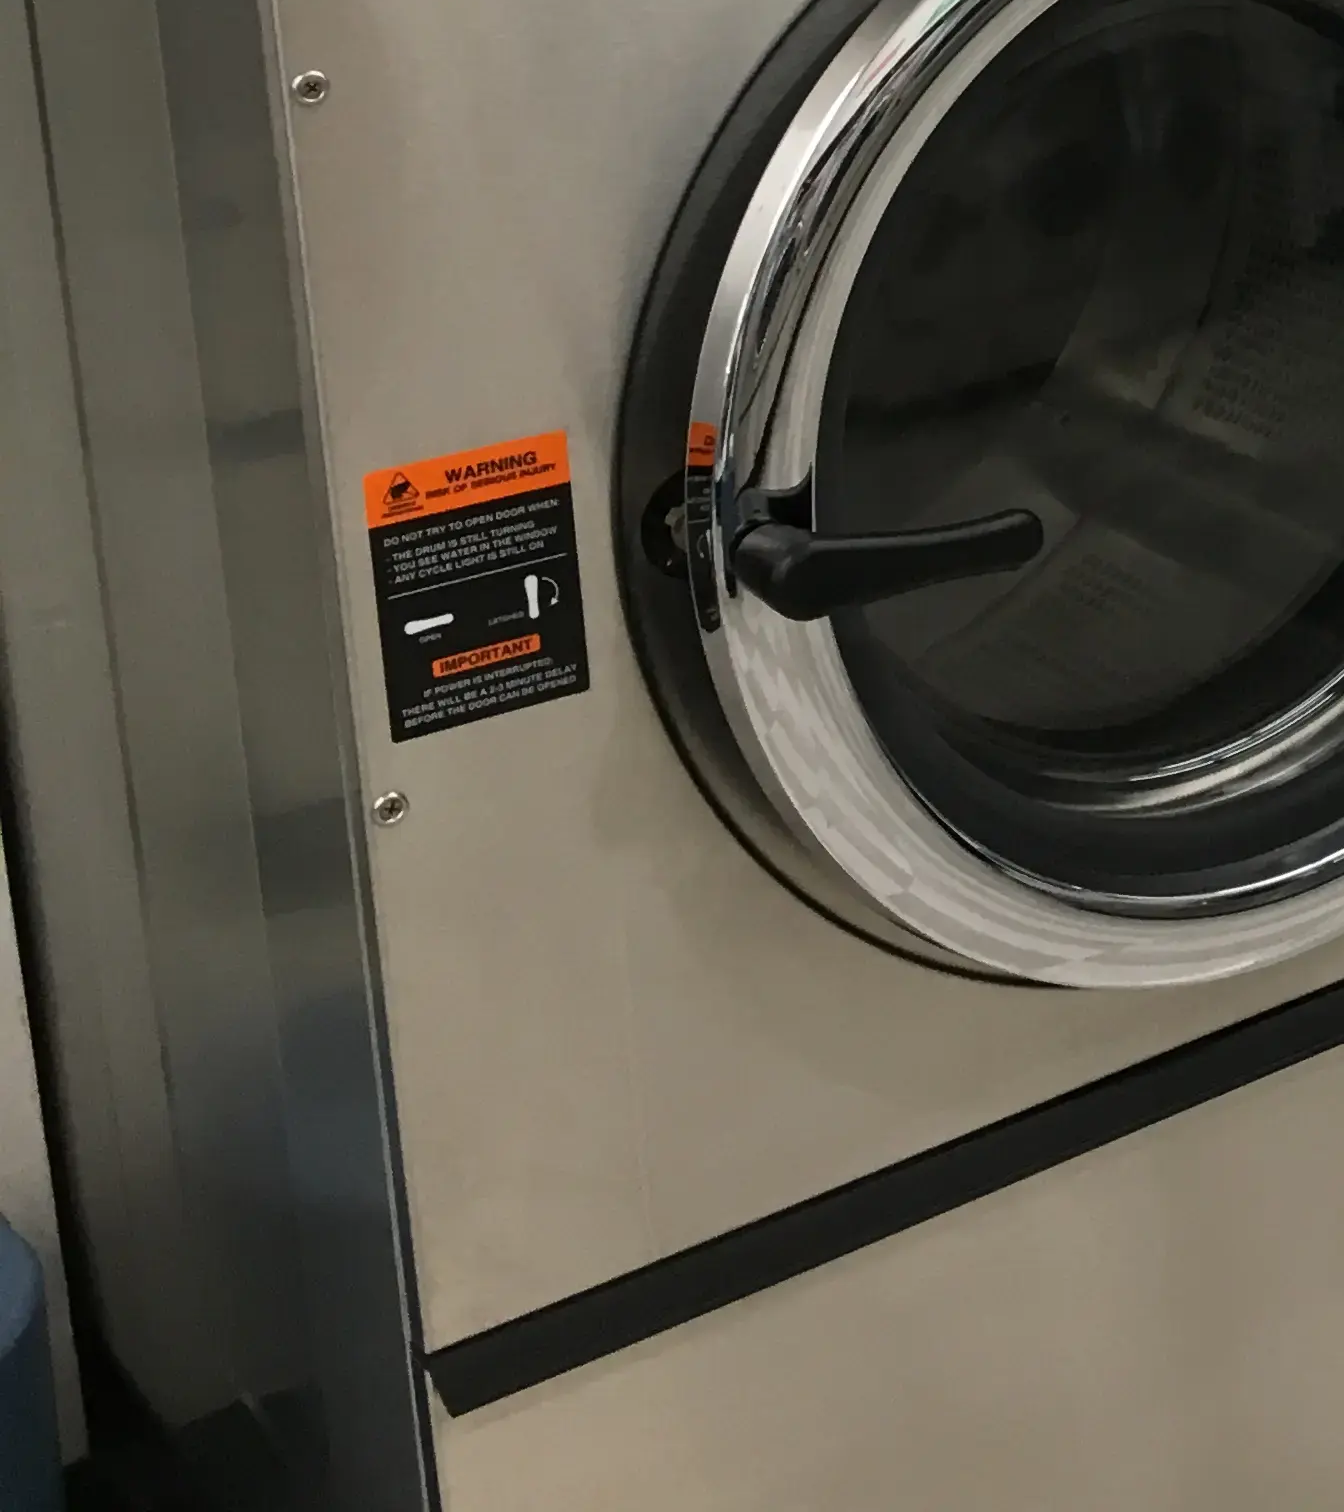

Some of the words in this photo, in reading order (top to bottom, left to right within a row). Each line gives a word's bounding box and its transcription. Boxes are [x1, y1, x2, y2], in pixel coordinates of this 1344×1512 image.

[444, 451, 537, 484] WARNING
[383, 537, 399, 547] DO
[402, 531, 424, 543] NOT
[426, 525, 447, 538] TRY
[448, 521, 463, 531] TO
[465, 514, 493, 528] OPEN
[496, 506, 526, 521] DOOR
[527, 499, 560, 514] WHEN:
[392, 549, 414, 562] THE
[415, 543, 445, 558] DRUM
[448, 538, 458, 547] IS
[460, 531, 488, 546] STILL
[491, 520, 535, 538] TURNING
[393, 559, 416, 573] YOU
[418, 555, 438, 567] SEE
[441, 546, 478, 563] WATER
[479, 543, 490, 552] IN
[491, 538, 513, 551] THE
[514, 525, 558, 545] WINDOW
[395, 571, 416, 584] ANY
[418, 561, 453, 579] CYCLE
[455, 555, 485, 570] LIGHT
[487, 552, 497, 561] IS
[500, 545, 526, 559] STILL
[529, 541, 544, 552] ON
[440, 639, 533, 673] IMPORTANT
[402, 701, 435, 718] THERE
[437, 695, 463, 710] WILL
[464, 691, 478, 701] BE
[480, 689, 488, 698] A
[506, 673, 540, 691] MINUTE
[541, 663, 578, 681] DELAY
[404, 710, 446, 728] BEFORE
[447, 704, 466, 717] THE
[468, 697, 497, 711] DOOR
[499, 692, 520, 704] CAN
[537, 675, 576, 694] OPENED
[434, 679, 471, 696] POWER
